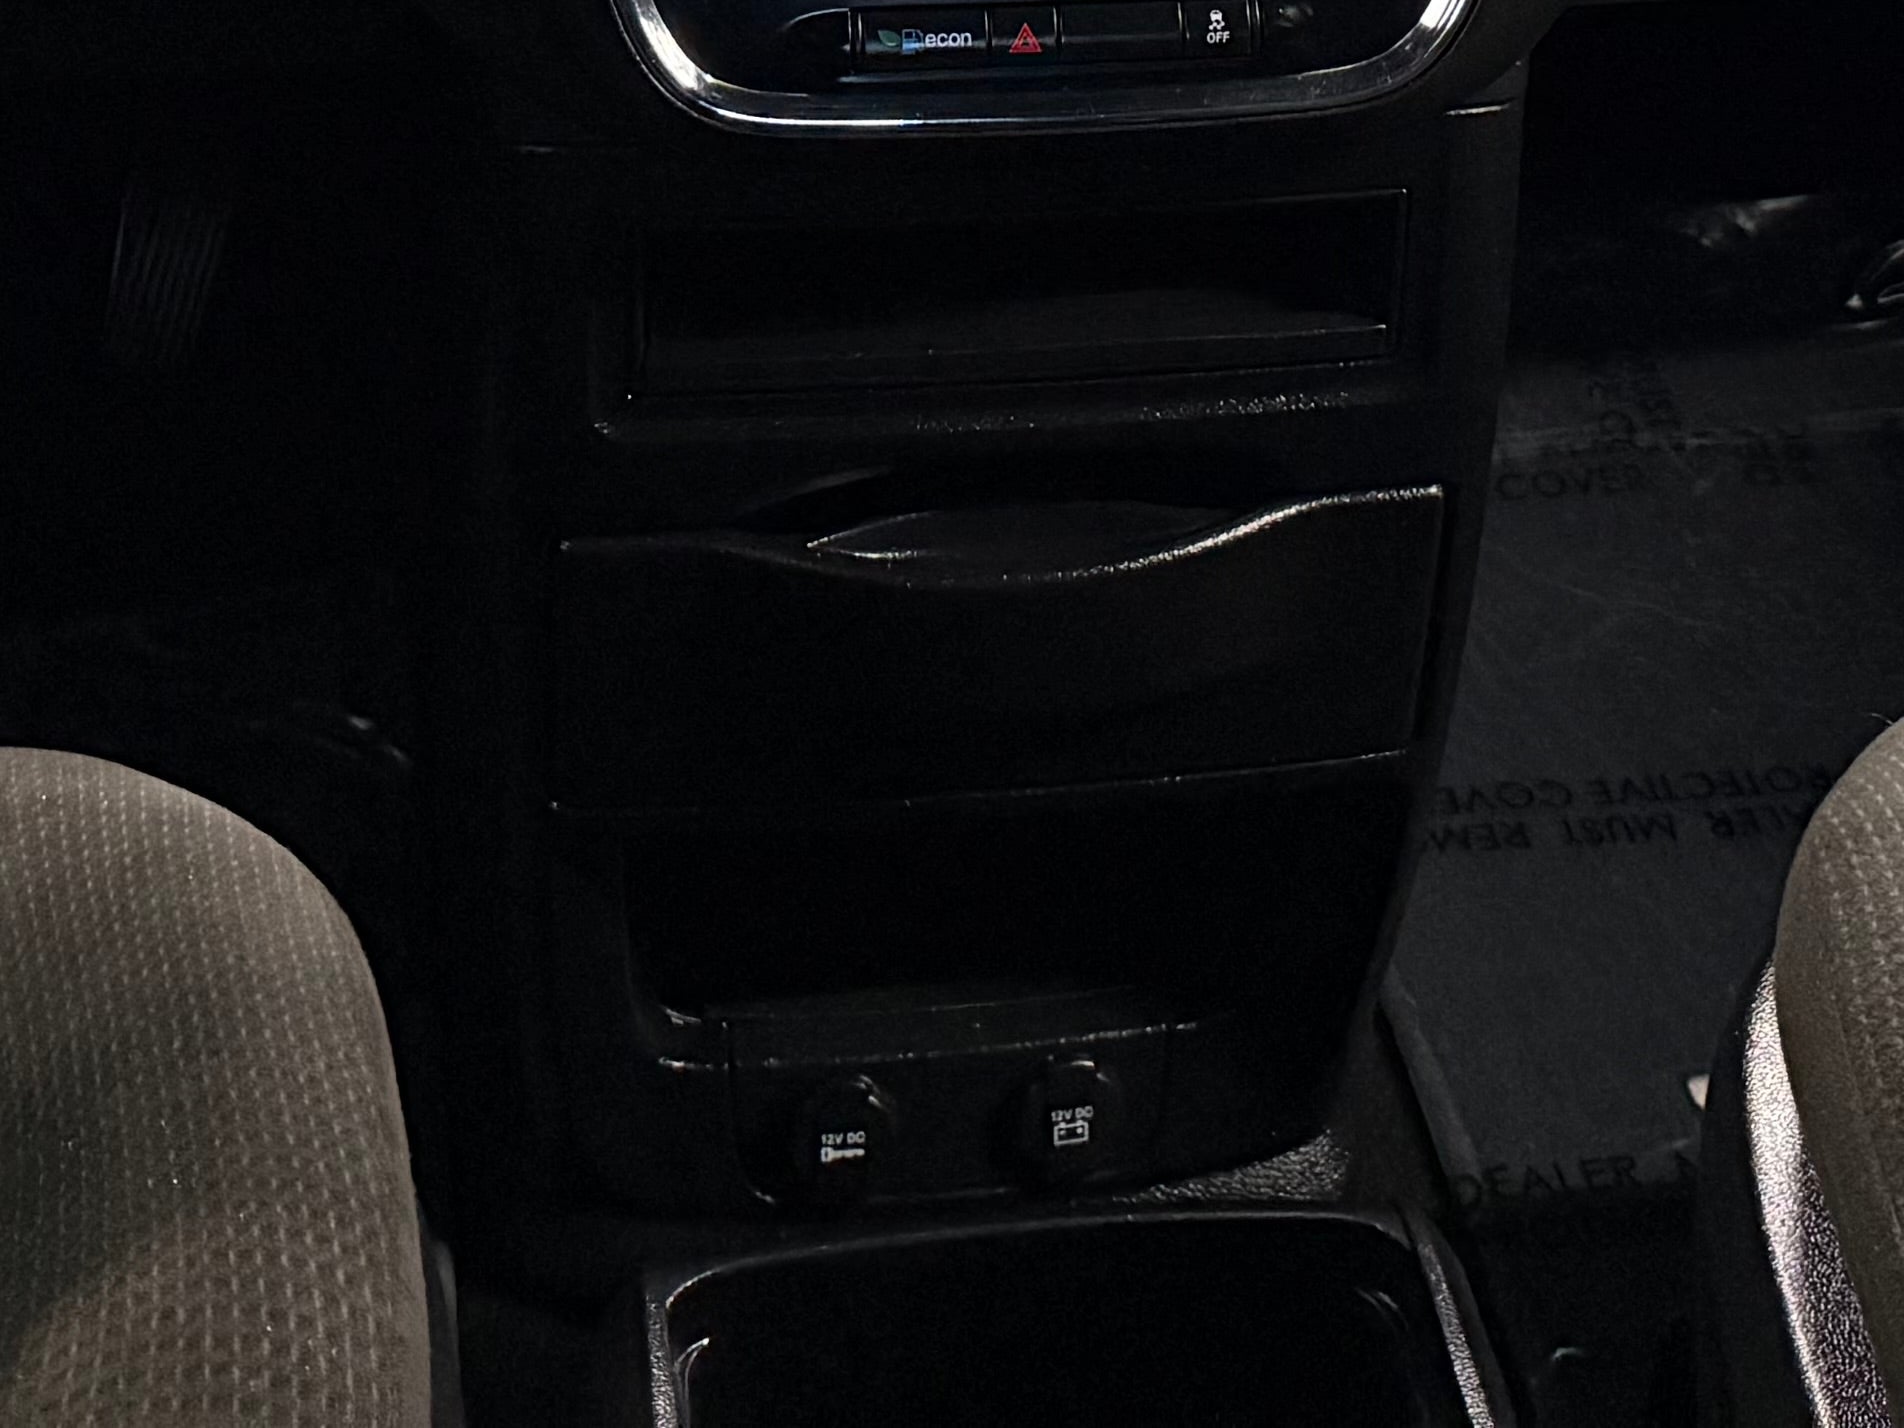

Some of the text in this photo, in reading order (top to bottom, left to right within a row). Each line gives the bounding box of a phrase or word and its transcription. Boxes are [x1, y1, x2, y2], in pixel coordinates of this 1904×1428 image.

[924, 30, 972, 48] econ
[1206, 31, 1230, 44] OFF
[1437, 765, 1834, 815] ROTECTIVE COVE
